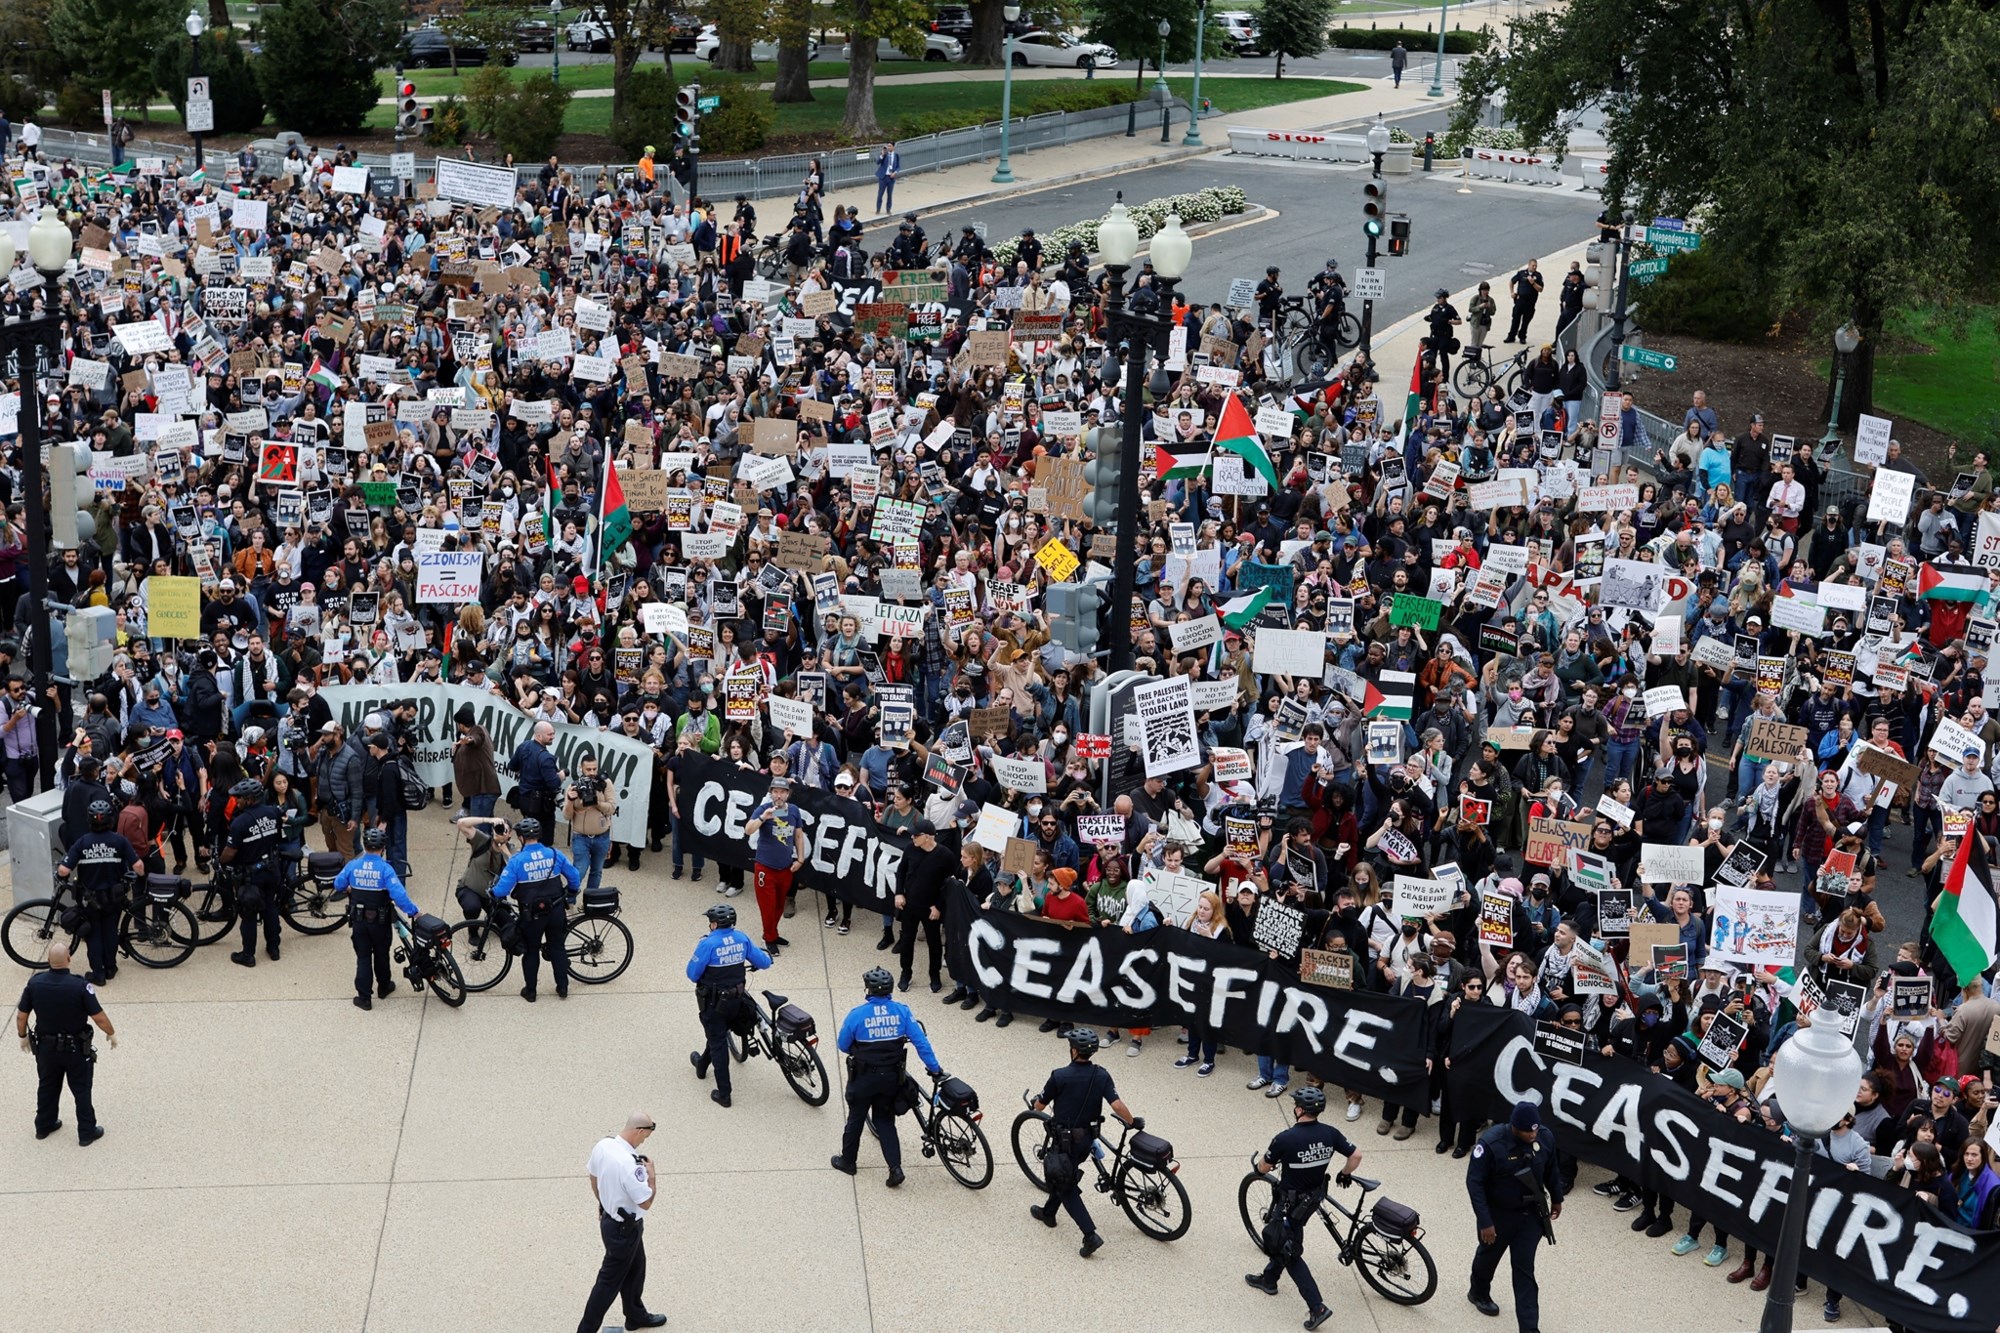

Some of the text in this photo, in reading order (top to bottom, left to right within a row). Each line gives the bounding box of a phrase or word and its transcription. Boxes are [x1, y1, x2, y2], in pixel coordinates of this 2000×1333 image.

[1267, 132, 1325, 144] STOP
[1477, 152, 1542, 166] STOP
[1650, 229, 1689, 247] Independence
[1656, 243, 1675, 254] UNIT
[1629, 260, 1659, 276] CAPITOL
[899, 271, 931, 285] FREE
[1639, 274, 1655, 283] 100
[207, 290, 245, 301] JEWS SAY
[884, 284, 948, 303] PALESTINE
[203, 309, 242, 320] NOW
[915, 313, 937, 325] FREE
[1023, 315, 1062, 324] GENOCIDE
[453, 338, 480, 347] CEASE
[1027, 334, 1060, 342] PALESTINE
[1047, 420, 1077, 428] GENOCIDE
[1260, 417, 1289, 429] CEASEFIRE
[1862, 418, 1890, 432] COLLECTIVE
[162, 431, 193, 441] GENOCIDE
[168, 426, 185, 434] STOP
[368, 431, 392, 440] NOW
[1342, 455, 1363, 465] SIEGE
[1857, 450, 1870, 460] WAR
[757, 468, 787, 483] CEASEFIRE
[1341, 464, 1364, 475] NOW
[1880, 473, 1898, 483] JEWS
[95, 479, 124, 491] NOW
[1215, 483, 1267, 496] COLONIZATION
[1583, 487, 1636, 499] NEVER AGAIN
[1580, 495, 1638, 510] NOT ANYONE
[1881, 495, 1905, 508] PEOPLE
[886, 506, 914, 518] JEWISH
[1880, 506, 1904, 520] GAZA
[880, 523, 913, 536] PALESTINE
[686, 543, 722, 552] GENOCIDE
[1038, 543, 1058, 564] LET
[419, 552, 482, 567] ZIONISM
[1044, 552, 1069, 572] GAZA
[1053, 559, 1077, 581] LIVE
[986, 580, 1019, 593] CEASE
[1883, 578, 1905, 590] GAZA
[275, 591, 299, 601] NOT IN
[419, 584, 479, 598] FASCISM
[278, 597, 298, 606] OUR
[324, 596, 348, 606] NOT IN
[1393, 594, 1440, 616] CEASEFIRE
[874, 603, 923, 625] LET GAZA
[1401, 611, 1432, 626] NOW!
[881, 620, 916, 638] LIVE
[1177, 625, 1216, 644] GENOCIDE
[1482, 631, 1517, 647] OCCUPATION
[1711, 644, 1730, 655] STOP
[617, 655, 641, 664] CEASE
[1828, 654, 1855, 667] CEASE
[1758, 663, 1785, 673] CEASE
[1829, 662, 1850, 672] FIRE
[1760, 671, 1781, 680] FIRE
[1825, 669, 1852, 681] GAZA
[1875, 674, 1905, 688] GENOCIDE
[728, 684, 755, 693] CEASE
[895, 687, 914, 696] WANTS
[1757, 680, 1784, 690] GAZA
[730, 691, 752, 700] FIRE
[889, 694, 906, 702] ERASE
[1137, 681, 1189, 703] FREE PALESTINE!
[1216, 691, 1228, 699] TO
[727, 700, 755, 710] GAZA
[1156, 693, 1175, 706] BACK
[1193, 695, 1235, 707] APARTHEID
[1140, 698, 1190, 719] STOLEN LAND
[773, 708, 808, 724] CEASEFIRE
[780, 720, 798, 730] NOW
[1943, 723, 1967, 740] NO TO
[1489, 733, 1506, 743] END
[1758, 721, 1801, 743] FREE
[1948, 734, 1962, 746] NO
[1750, 737, 1803, 758] PALESTINE
[155, 748, 173, 764] HUMANITY
[1216, 753, 1247, 764] CEASEFIRE
[556, 731, 640, 801] NOW!
[936, 760, 948, 773] END
[1006, 764, 1029, 774] STOP
[1216, 767, 1249, 778] GENOCIDE
[1225, 762, 1239, 770] NOT
[998, 768, 1040, 782] GENOCIDE
[1010, 778, 1035, 788] GAZA
[248, 818, 277, 835] CAPITOL
[1078, 815, 1123, 827] CEASEFIRE
[1531, 816, 1567, 837] JEWS
[1947, 822, 1968, 832] NOW!
[251, 823, 277, 838] POLICE
[1087, 826, 1112, 839] GAZA
[1227, 826, 1256, 838] CEASE
[692, 781, 905, 900] CEEFIR
[1230, 833, 1254, 843] FIRE
[82, 847, 119, 857] CAPITOL
[92, 842, 107, 851] U.S.
[1387, 837, 1412, 862] GAZA
[1657, 846, 1682, 860] JEWS
[85, 853, 115, 861] POLICE
[1648, 859, 1696, 873] AGAINST
[353, 869, 382, 882] CAPITOL
[527, 867, 555, 881] POLICE
[1646, 869, 1700, 884] APARTHEID
[355, 877, 379, 890] POLICE
[1155, 872, 1209, 900] LET
[1402, 883, 1427, 894] JEWS
[1400, 891, 1448, 905] CEASEFIRE
[1283, 904, 1305, 922] ARE
[1412, 903, 1436, 913] NOW
[1483, 901, 1511, 917] CEASE
[1258, 904, 1303, 932] NEUTRAL
[1483, 910, 1508, 925] FIRE
[1481, 922, 1511, 937] GAZA
[715, 942, 745, 959] CAPITOL
[718, 952, 744, 965] POLICE
[1304, 951, 1351, 969] BLACK IS
[1577, 980, 1615, 993] GENOCIDE
[967, 918, 1400, 1084] CEASEFIRE.
[873, 1005, 889, 1017] U.S.
[863, 1014, 901, 1029] CAPITOL
[867, 1026, 899, 1040] POLICE
[1535, 1028, 1586, 1050] SETTLER COLONIALISM
[1551, 1041, 1573, 1055] GENOCIDE
[1308, 1142, 1326, 1152] U.S.
[1301, 1152, 1333, 1164] POLICE
[1492, 1034, 1978, 1319] CEASEFIRE.
